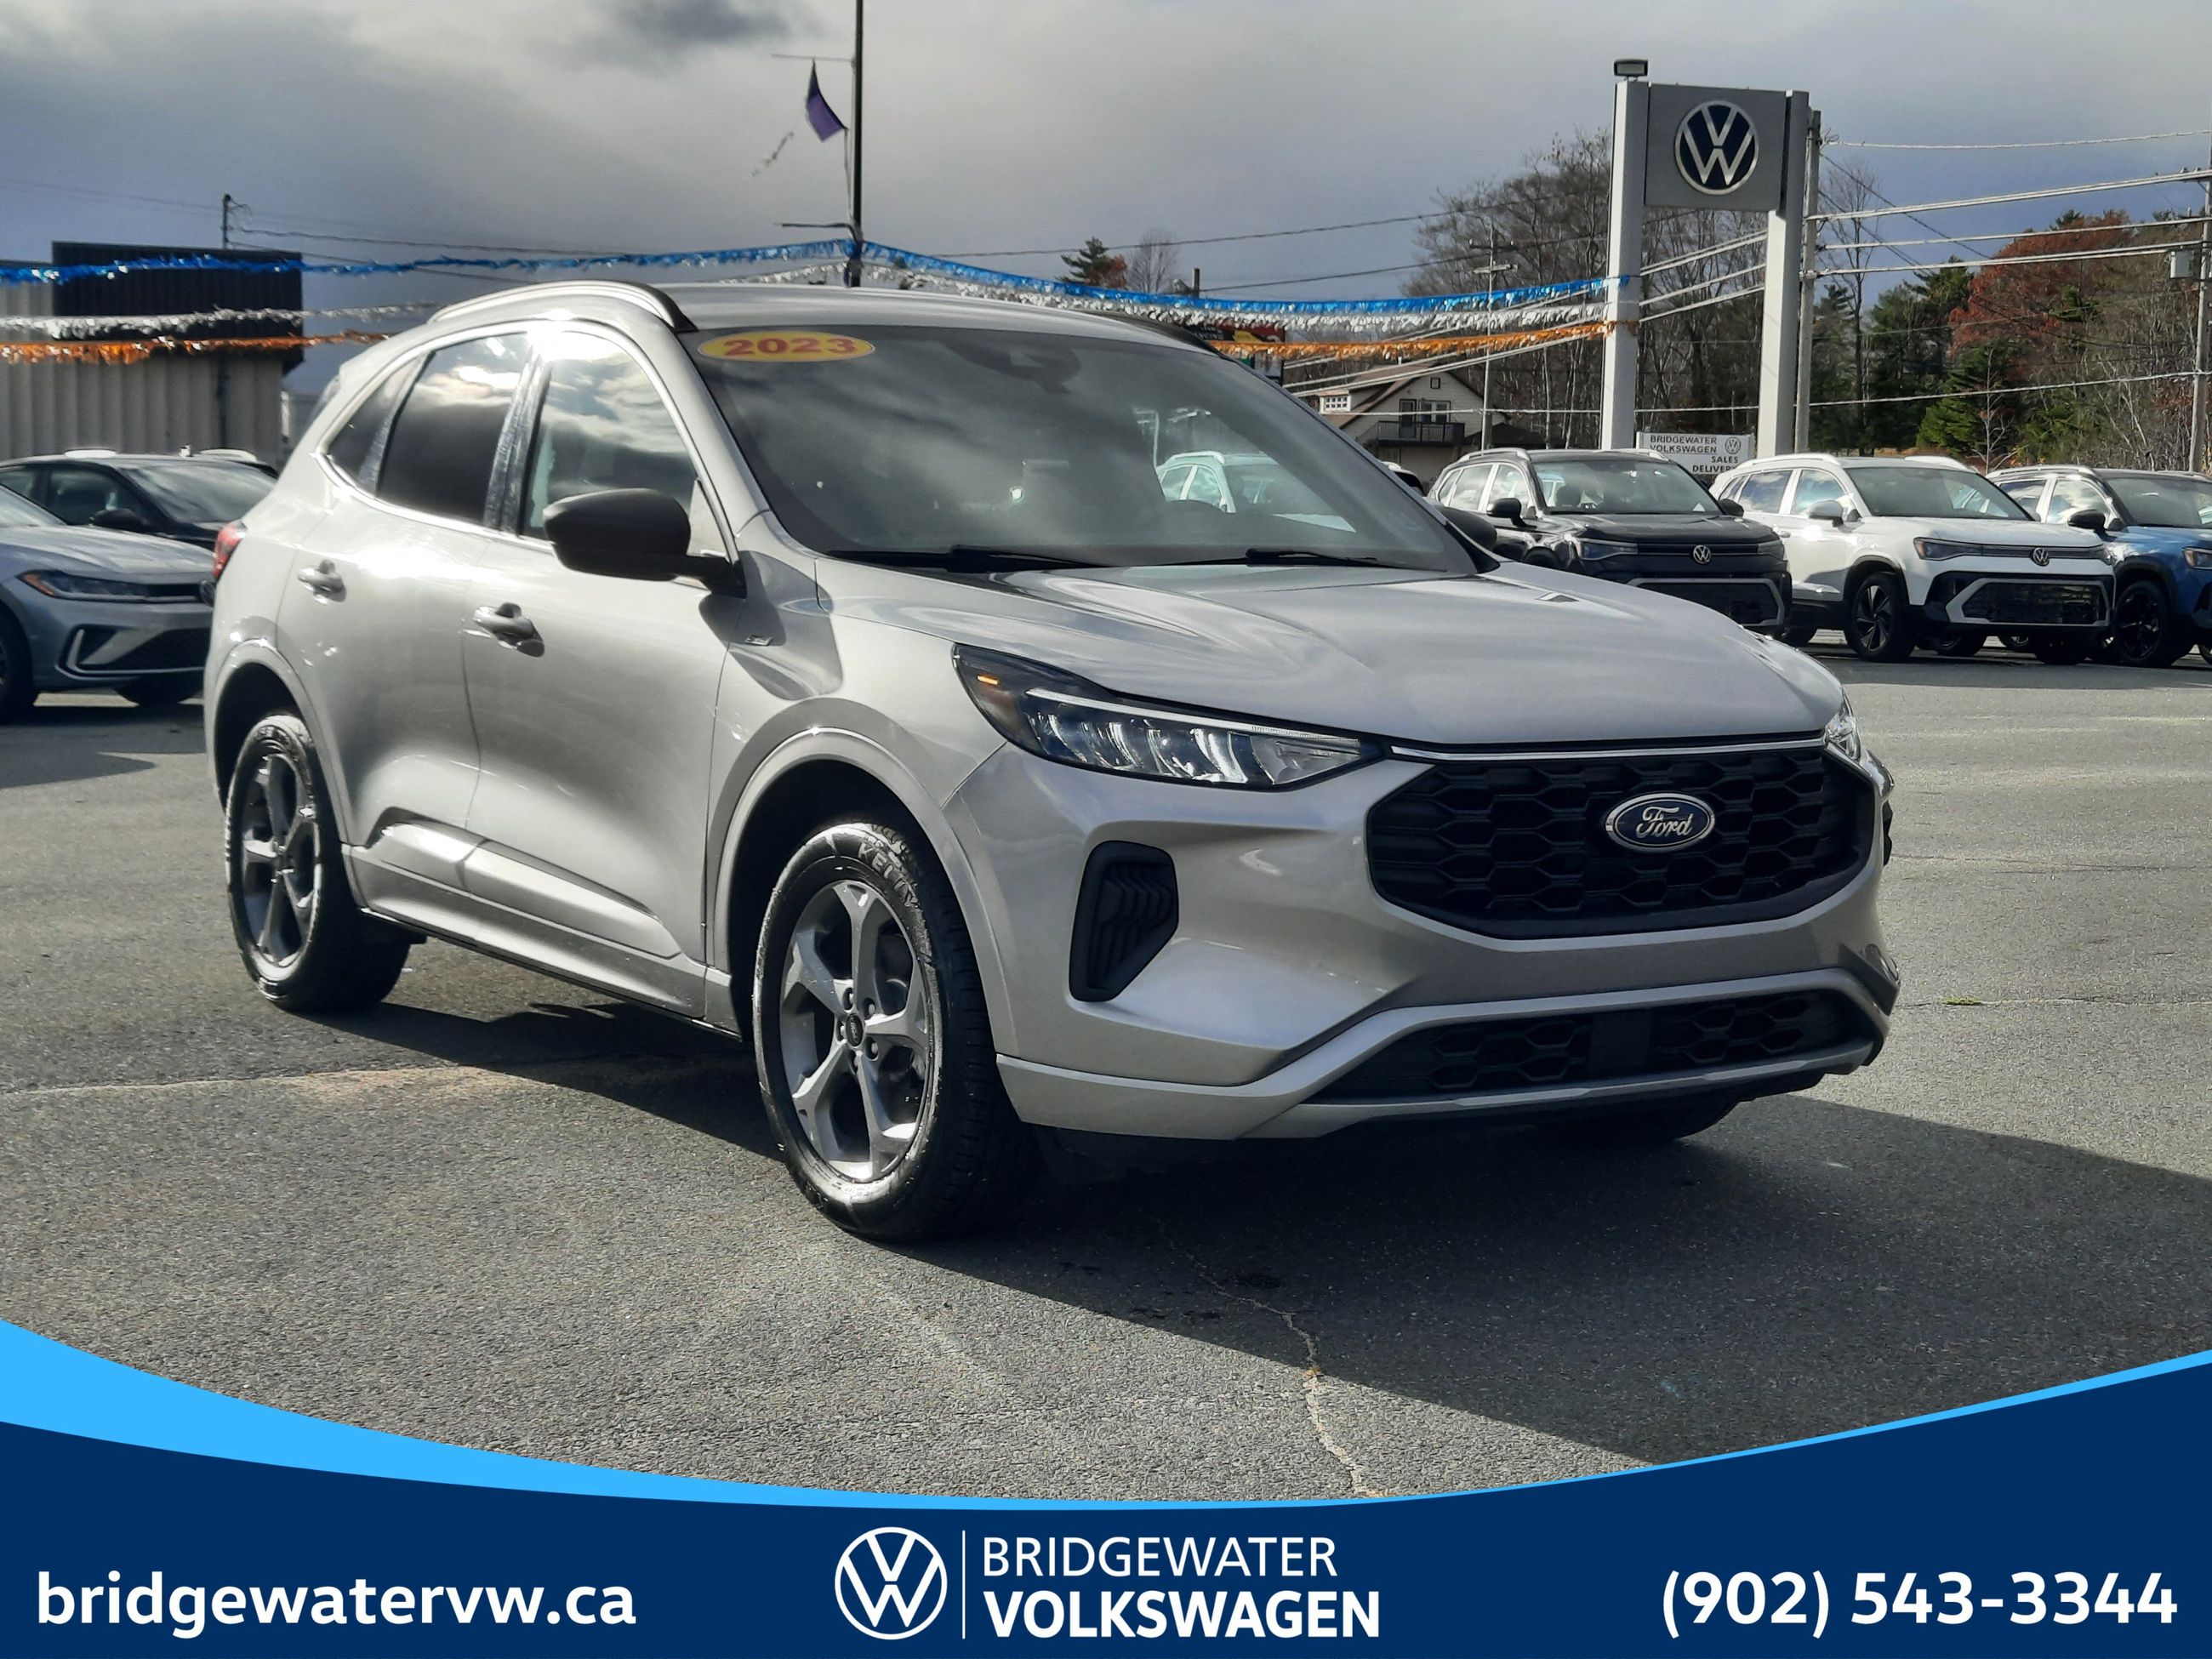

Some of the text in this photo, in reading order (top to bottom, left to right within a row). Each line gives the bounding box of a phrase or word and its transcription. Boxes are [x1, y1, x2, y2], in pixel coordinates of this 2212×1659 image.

[724, 338, 857, 356] 2023
[1650, 435, 1717, 444] BRIDGEWATER
[1650, 444, 1717, 453] VOLKSWAGEN
[1636, 806, 1694, 863] Ford
